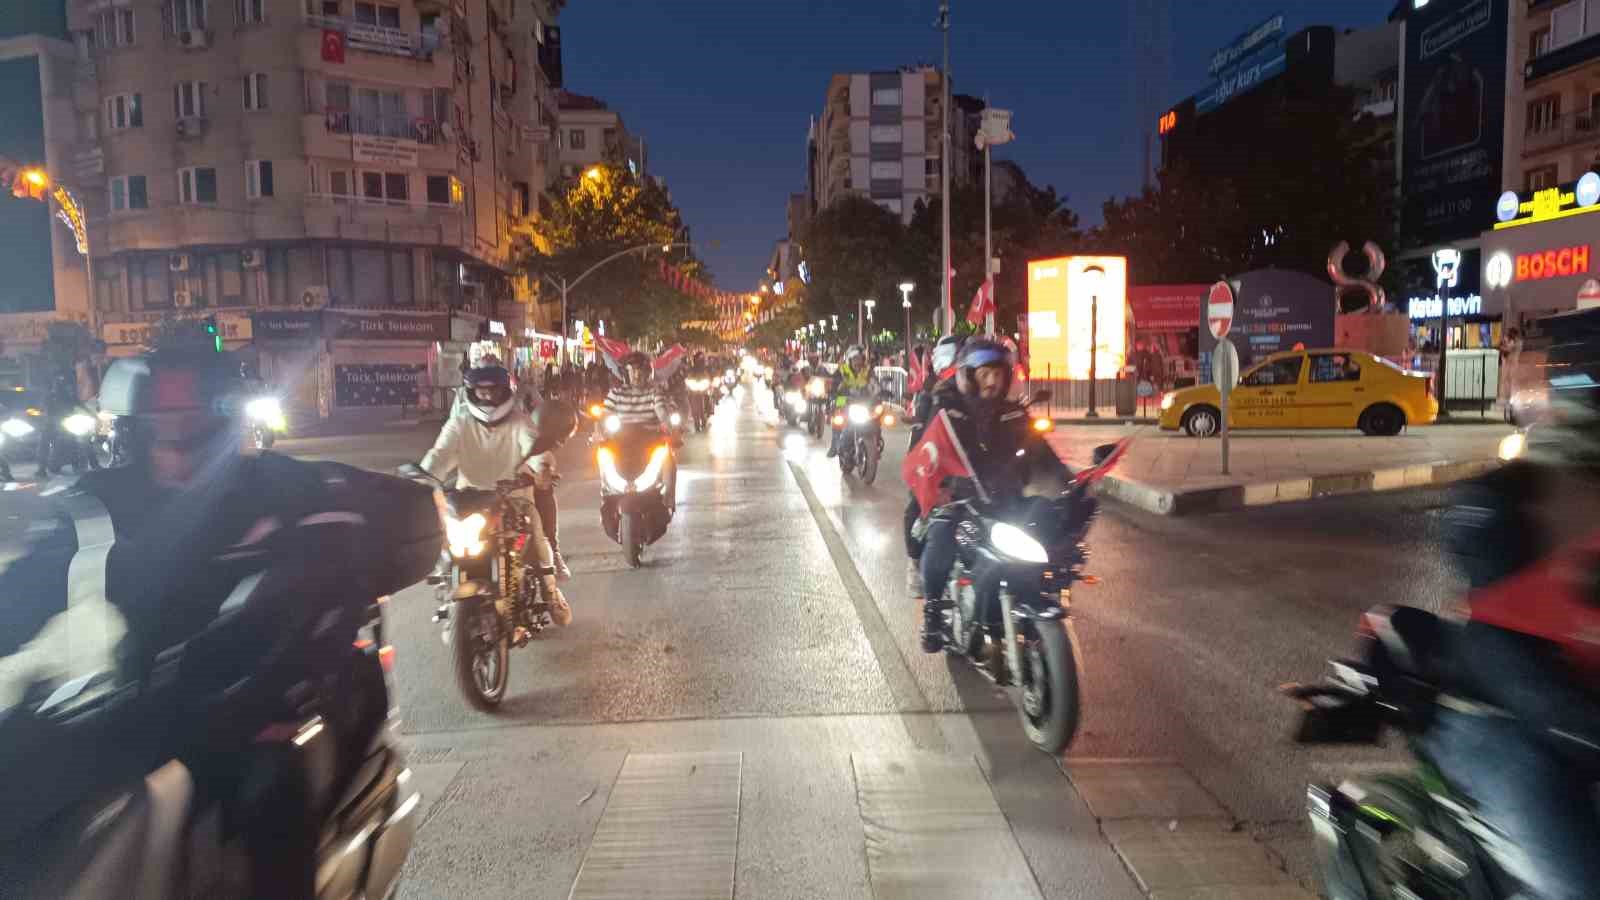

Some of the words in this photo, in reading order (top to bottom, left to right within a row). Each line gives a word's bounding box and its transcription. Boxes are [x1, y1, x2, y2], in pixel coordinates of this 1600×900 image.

[1515, 245, 1590, 282] BOSCH
[360, 318, 384, 331] Türk
[389, 319, 433, 332] Telekom
